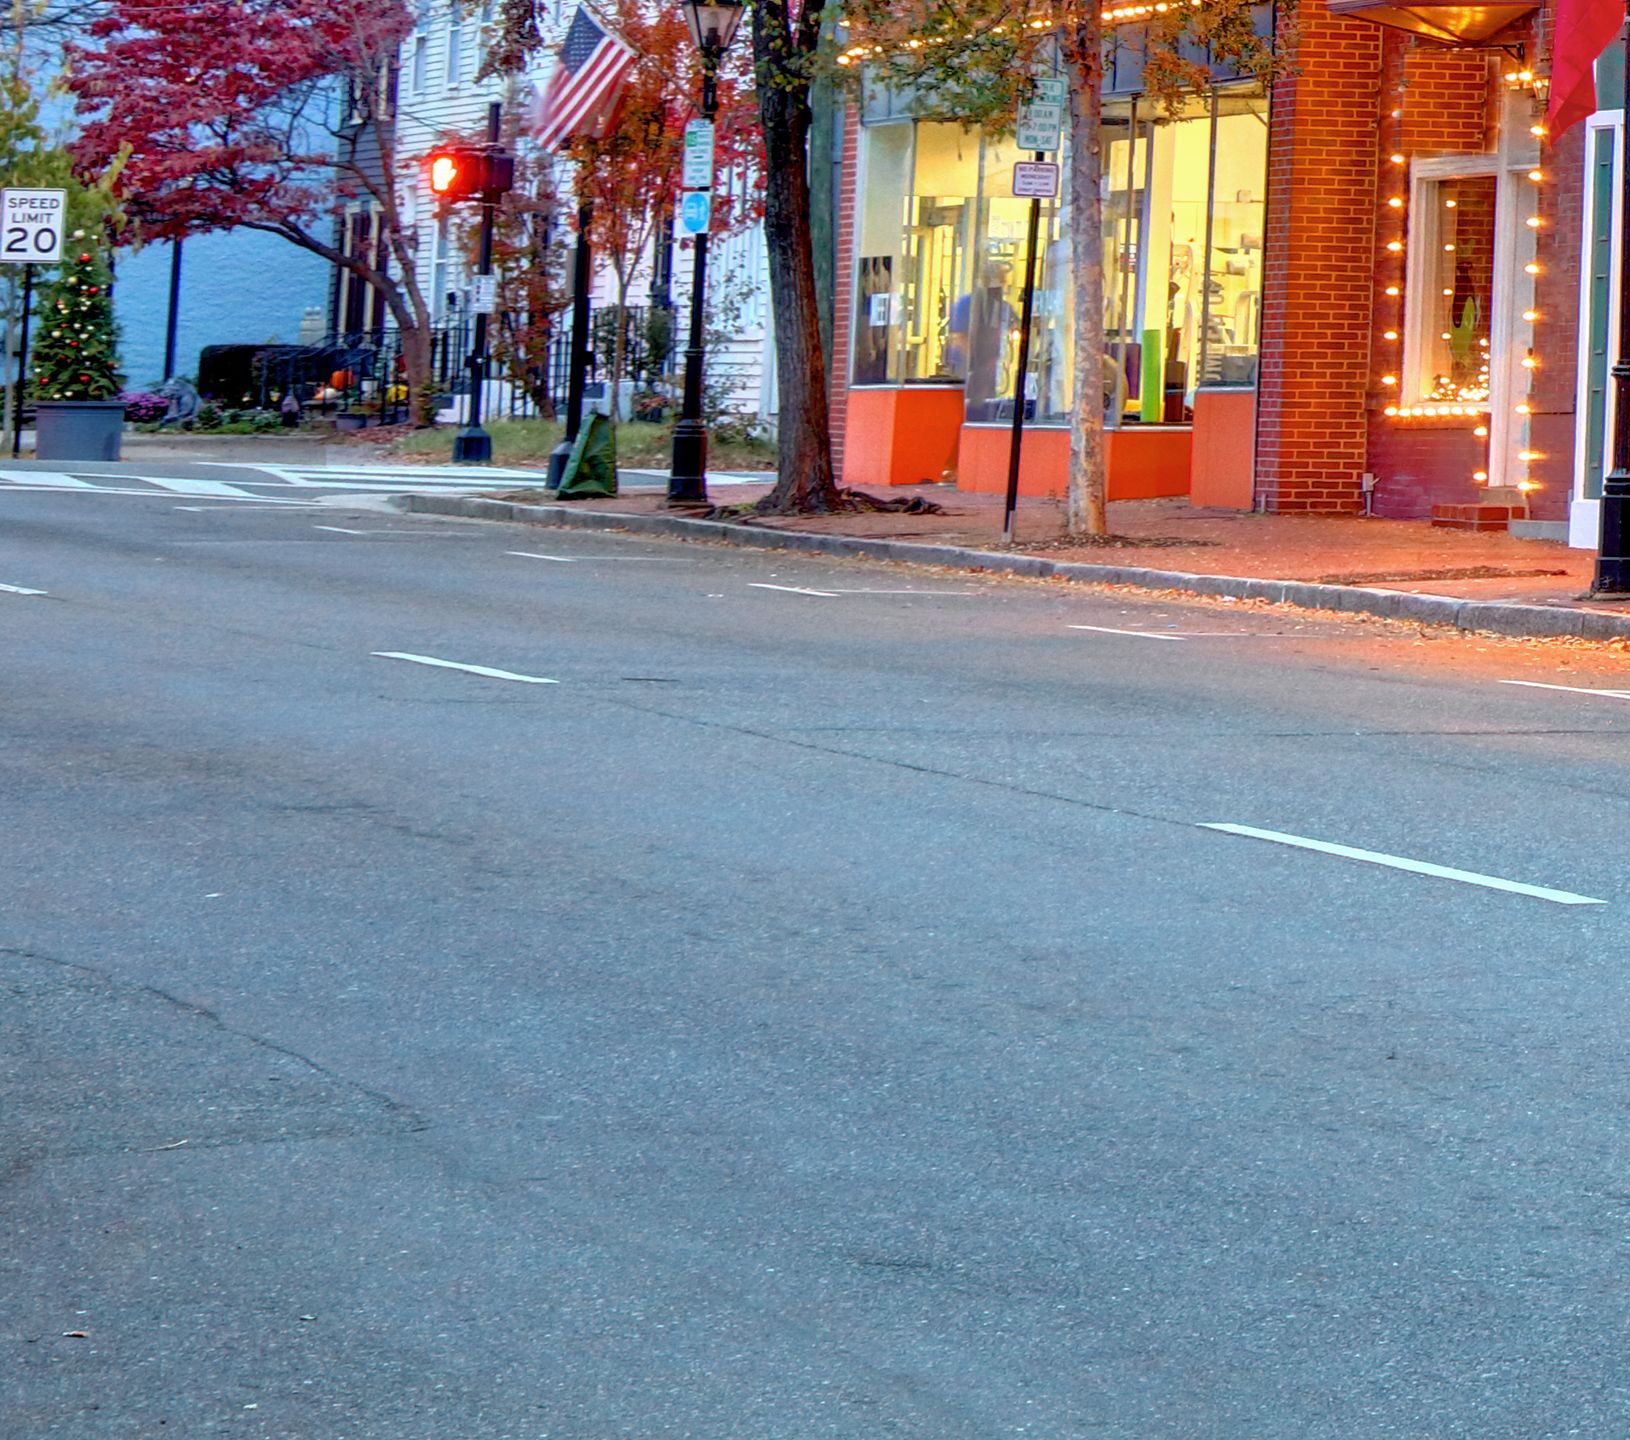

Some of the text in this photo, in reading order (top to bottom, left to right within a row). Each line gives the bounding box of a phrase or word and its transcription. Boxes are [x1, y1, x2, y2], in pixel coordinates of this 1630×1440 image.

[8, 197, 60, 209] SPEED
[12, 212, 54, 224] LIMIT
[5, 227, 57, 254] 20
